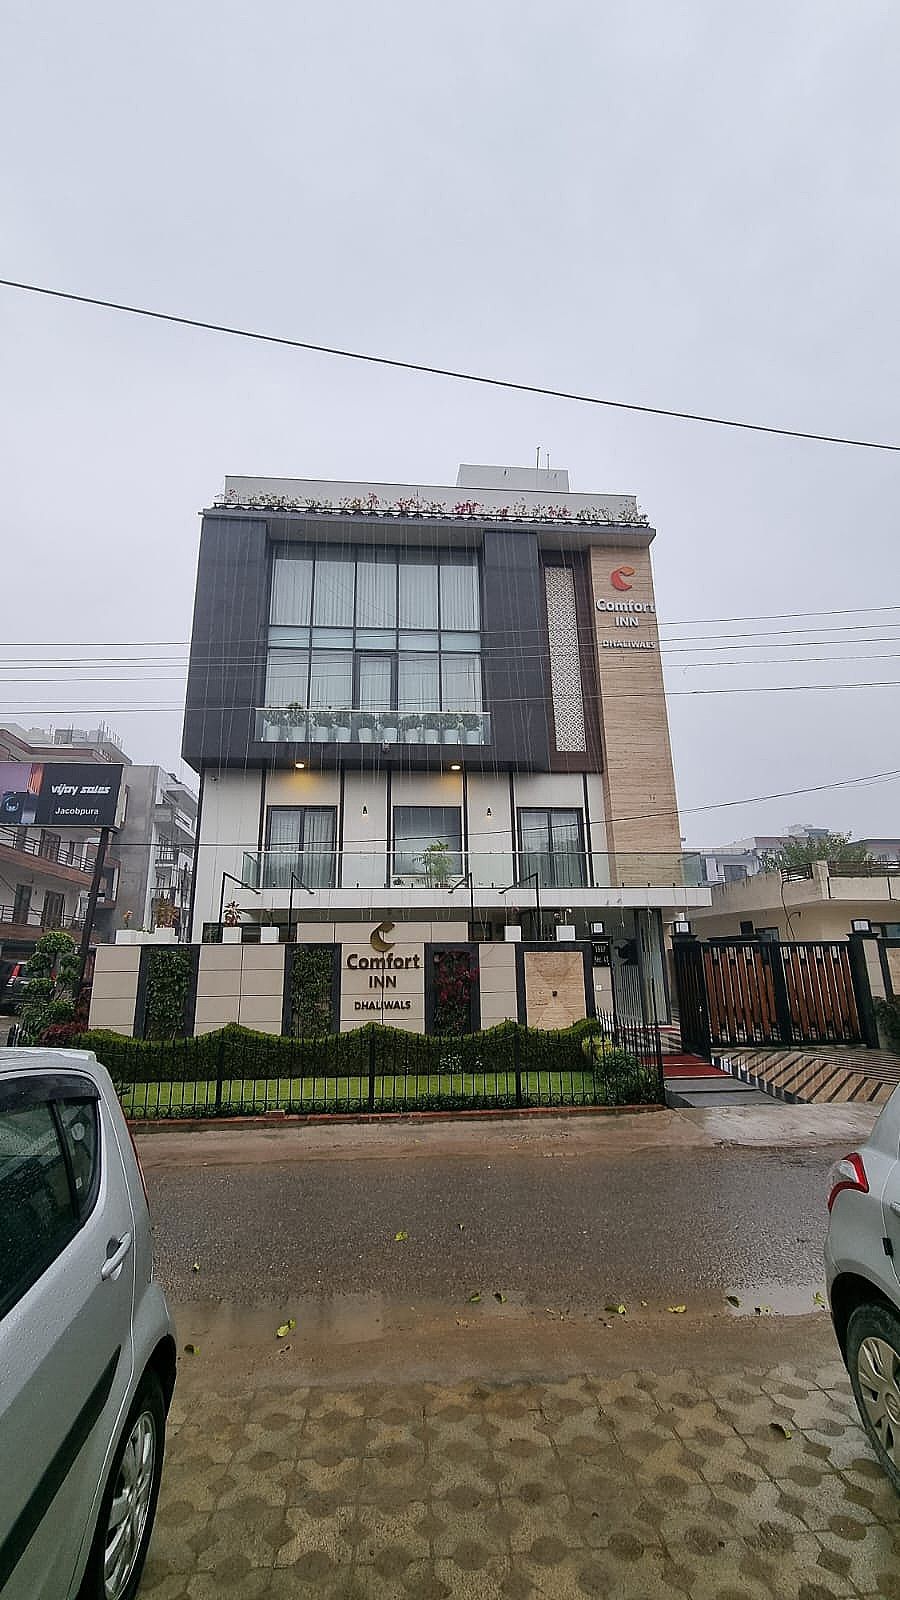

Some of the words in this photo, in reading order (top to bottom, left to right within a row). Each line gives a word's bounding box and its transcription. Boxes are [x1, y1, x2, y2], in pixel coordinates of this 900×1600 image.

[596, 598, 656, 613] Comfort
[615, 616, 639, 627] INN
[602, 639, 657, 649] DHALIWALS
[80, 785, 111, 794] sales
[55, 807, 99, 816] Jacobpura
[346, 952, 420, 970] Comfort
[369, 975, 396, 988] INN
[354, 1000, 411, 1010] DHALIWALS
